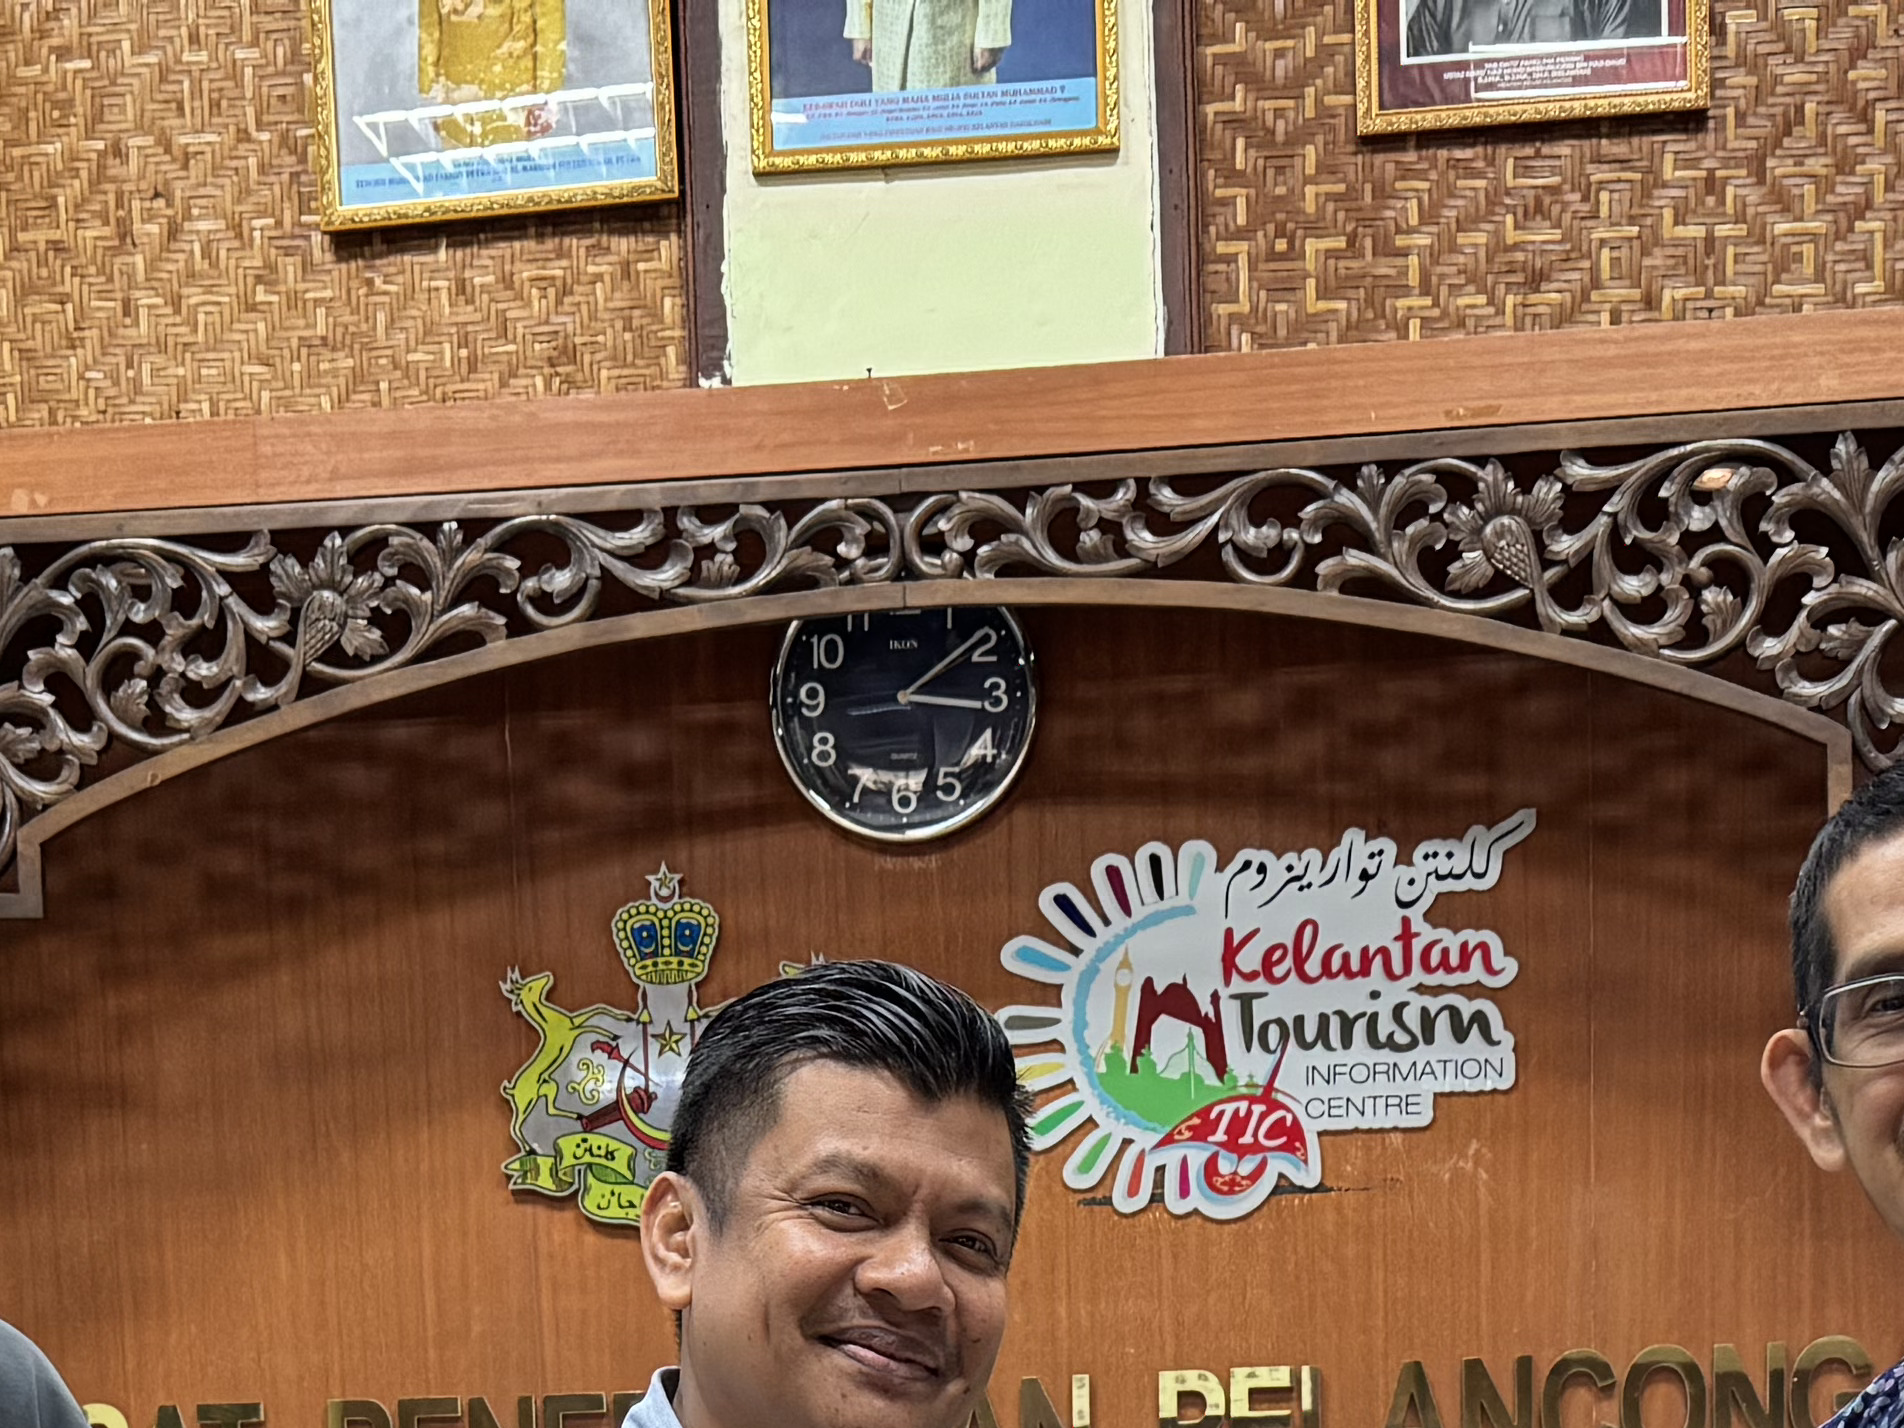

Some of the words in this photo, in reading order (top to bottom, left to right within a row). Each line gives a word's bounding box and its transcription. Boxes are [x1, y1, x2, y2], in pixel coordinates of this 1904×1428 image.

[810, 633, 845, 669] 10
[889, 639, 918, 650] IKON
[971, 626, 998, 662] 2
[799, 682, 826, 717] 9
[983, 677, 1009, 713] 3
[811, 731, 837, 767] 8
[969, 727, 998, 763] 4
[847, 767, 873, 803] 7
[891, 780, 918, 814] 6
[935, 766, 963, 801] 5
[1221, 915, 1507, 988] Kelantan
[1229, 989, 1502, 1054] Tourism
[1304, 1057, 1504, 1087] INFORMATION
[1206, 1100, 1293, 1147] TIC
[1304, 1093, 1423, 1120] CENTRE
